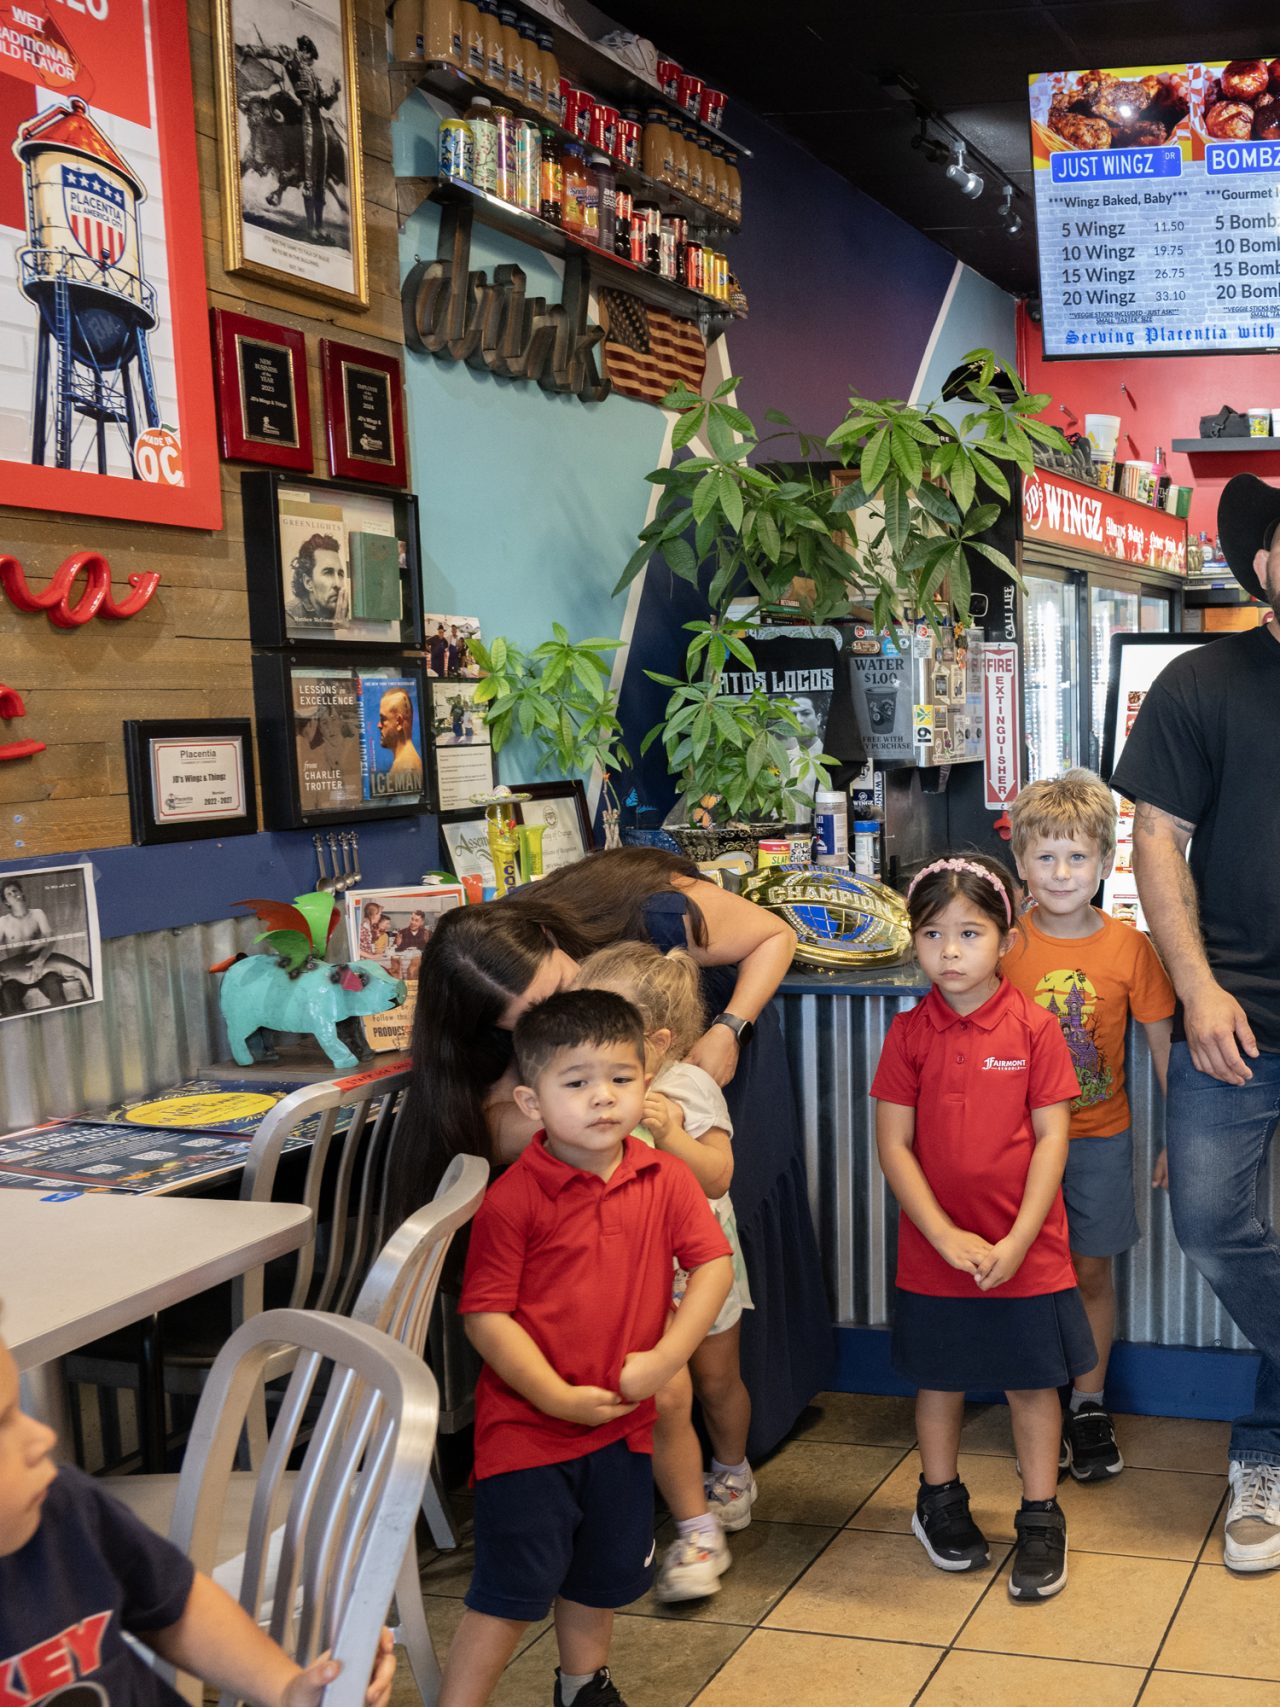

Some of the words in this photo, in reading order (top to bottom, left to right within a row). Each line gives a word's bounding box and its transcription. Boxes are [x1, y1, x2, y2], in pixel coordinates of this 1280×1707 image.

[11, 5, 45, 31] WET
[0, 26, 73, 68] ADITIONAL
[23, 49, 76, 82] FLAVOR
[1058, 156, 1099, 179] JUST
[1102, 153, 1154, 176] WINGZ
[70, 191, 121, 219] PLACENTIA
[1062, 223, 1071, 238] 5
[1076, 221, 1126, 239] Wingz
[1154, 221, 1185, 232] 11.50
[1062, 246, 1081, 261] 10
[1085, 244, 1135, 262] Wingz
[1154, 245, 1184, 256] 19.75
[1215, 239, 1235, 254] 10
[1062, 269, 1081, 283] 15
[1086, 267, 1136, 284] Wingz
[1155, 268, 1185, 279] 26.75
[1213, 261, 1233, 277] 15
[1063, 291, 1082, 306] 20
[1086, 289, 1136, 307] Wingz
[1155, 291, 1186, 302] 33.10
[1216, 284, 1236, 300] 20
[1065, 328, 1135, 345] Serving
[1145, 325, 1227, 345] Placentia
[1238, 322, 1274, 339] with
[138, 446, 183, 485] OC
[1044, 483, 1103, 542] WINGZ
[283, 518, 342, 531] GREENLIGHTS
[1003, 585, 1015, 611] LIFE
[1005, 612, 1017, 640] CALI
[854, 659, 905, 671] WATER
[987, 658, 1013, 673] FIRE
[299, 685, 337, 694] LESSONS
[719, 671, 767, 694] ATOS
[771, 668, 834, 693] LOCOS
[300, 696, 354, 706] EXCELLENCE
[995, 675, 1007, 795] EXTINGUISHER
[180, 749, 217, 758] Placentia
[869, 742, 912, 750] PURCHASE
[304, 769, 341, 780] CHARLIE
[371, 772, 423, 794] ICEMAN
[305, 780, 343, 791] TROTTER
[768, 885, 892, 920] CHAMPION
